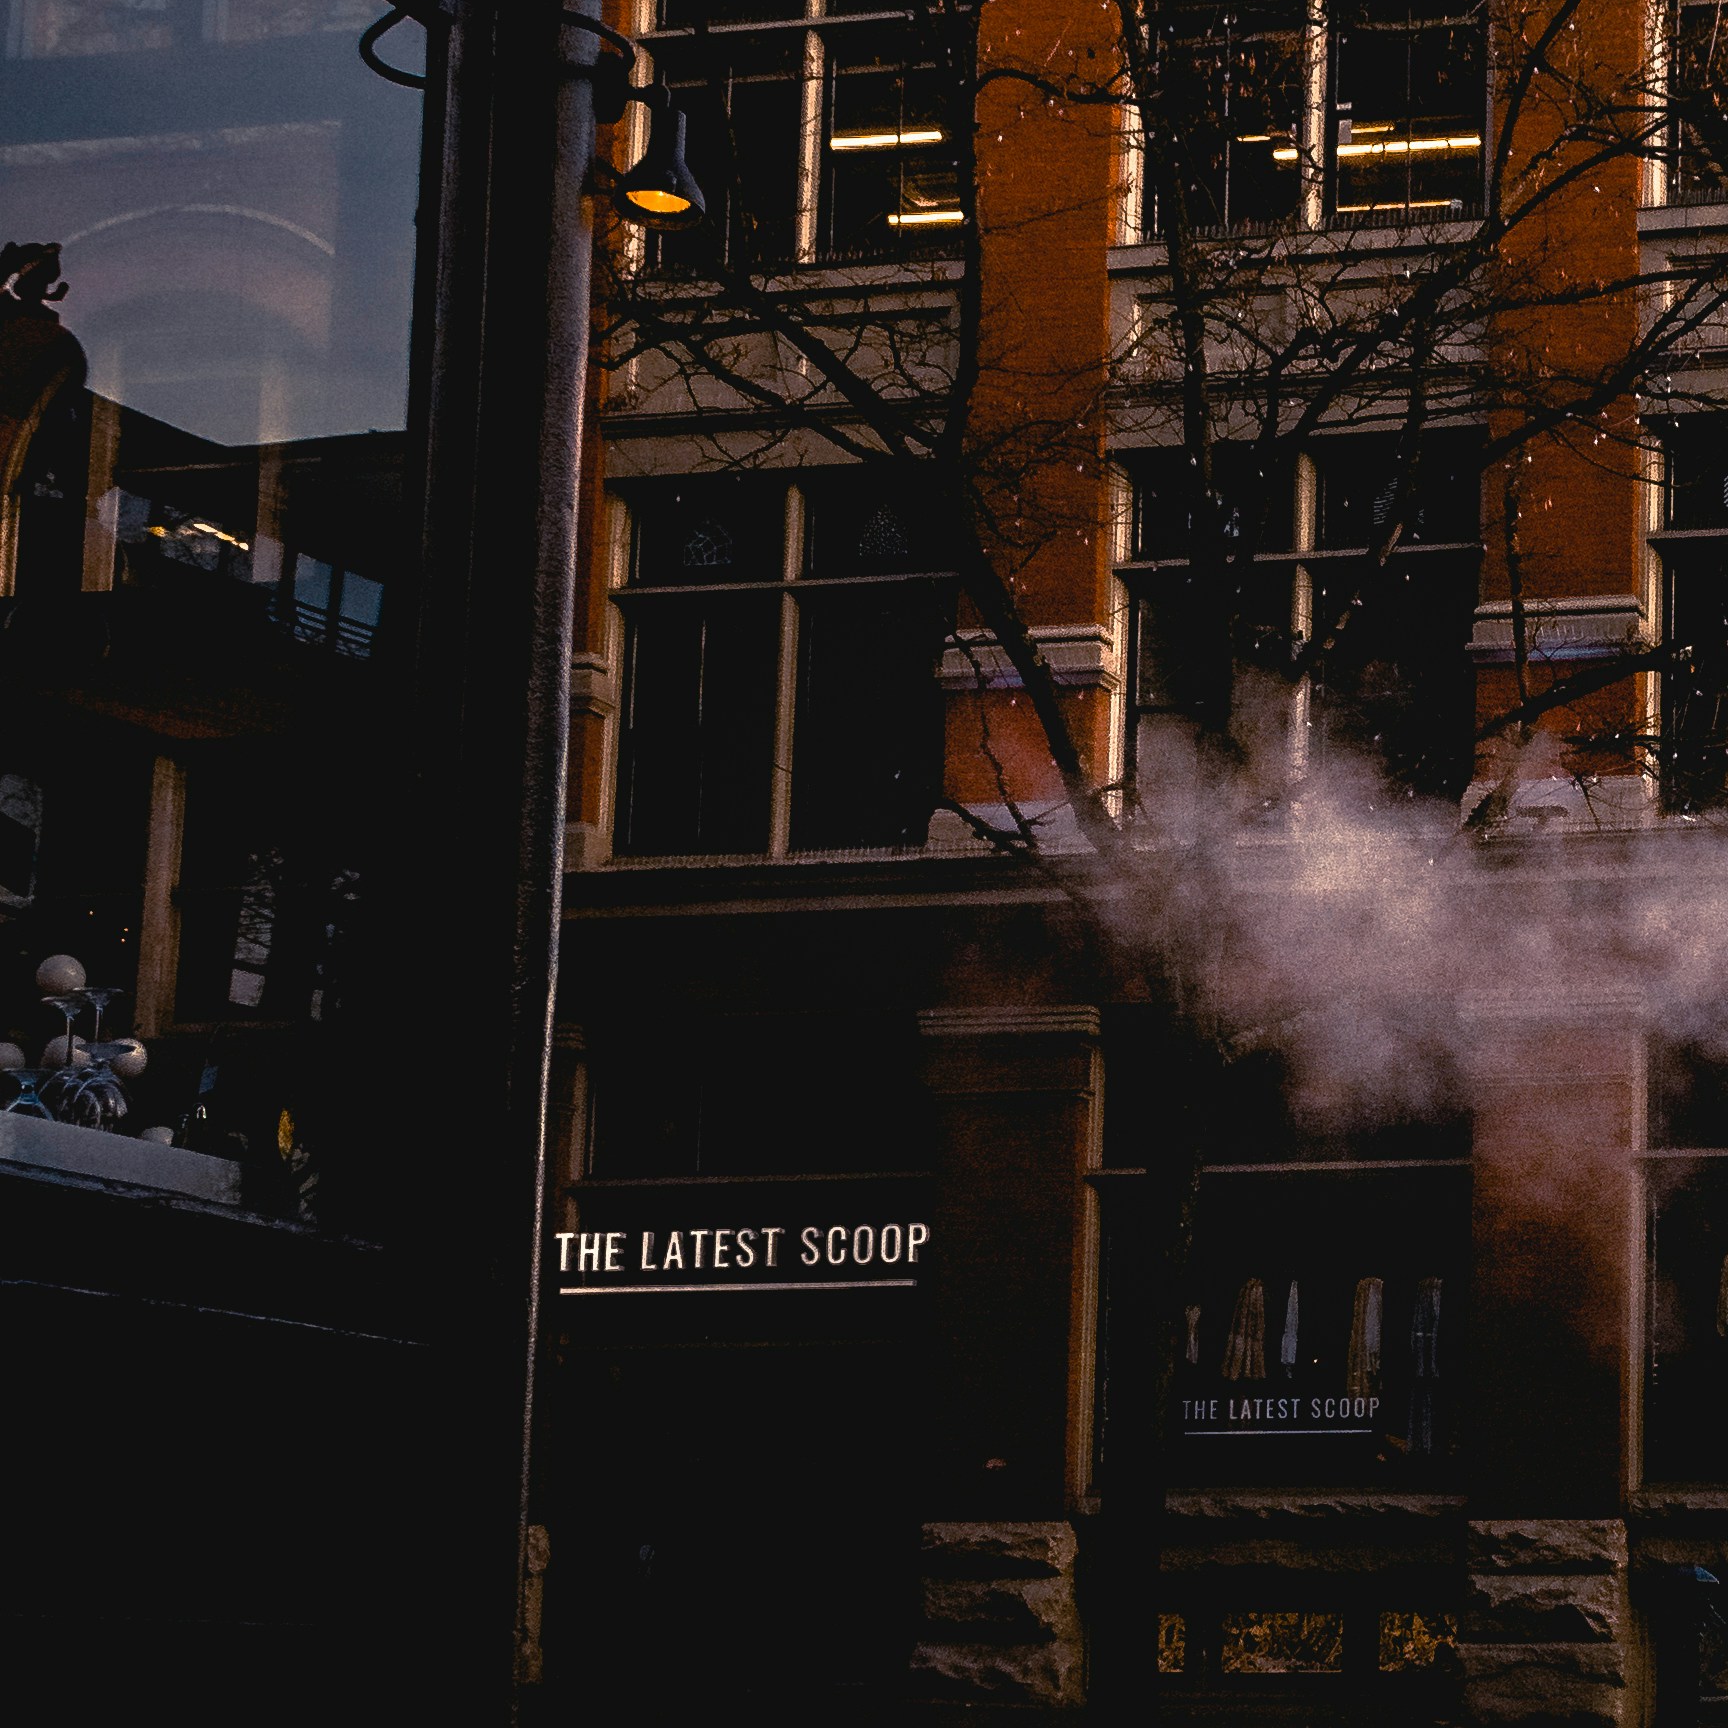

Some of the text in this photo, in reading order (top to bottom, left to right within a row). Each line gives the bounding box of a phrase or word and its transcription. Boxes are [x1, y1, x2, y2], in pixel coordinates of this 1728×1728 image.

[554, 1222, 930, 1272] THE LATEST SCOOP
[1182, 1397, 1380, 1420] THE LATEST SCOOP
